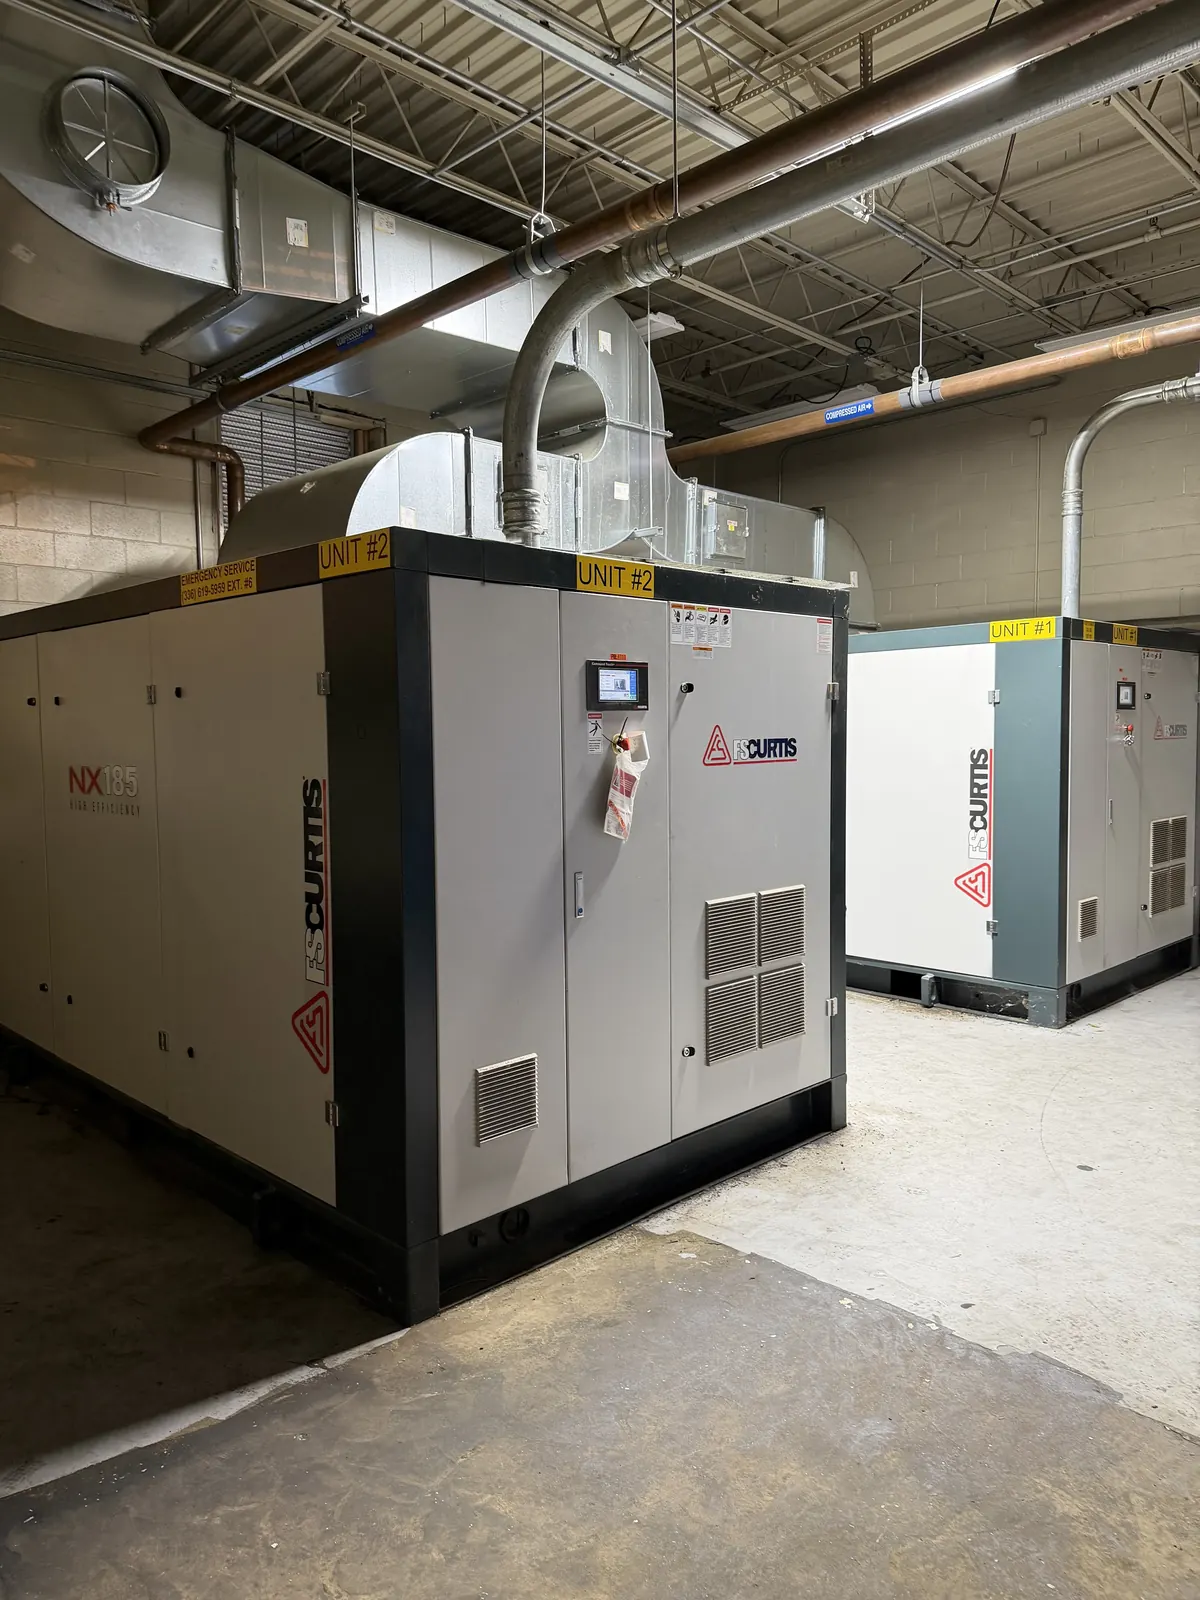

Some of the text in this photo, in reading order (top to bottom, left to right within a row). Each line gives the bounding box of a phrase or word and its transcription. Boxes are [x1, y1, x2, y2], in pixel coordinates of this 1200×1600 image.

[826, 403, 866, 420] COMPRESSED AIR
[320, 532, 388, 569] UNIT #2
[181, 560, 255, 587] EMERGENCY SERVICE
[579, 561, 652, 591] UNIT #2
[181, 577, 253, 605] (336) 619-5959 EXT. #6
[991, 620, 1052, 638] UNIT #1
[1113, 627, 1137, 643] UNIT #1
[732, 737, 798, 760] FSCURTIS
[69, 765, 138, 797] NX185
[968, 748, 989, 860] FSCURTIS
[302, 777, 326, 985] FSCURTIS
